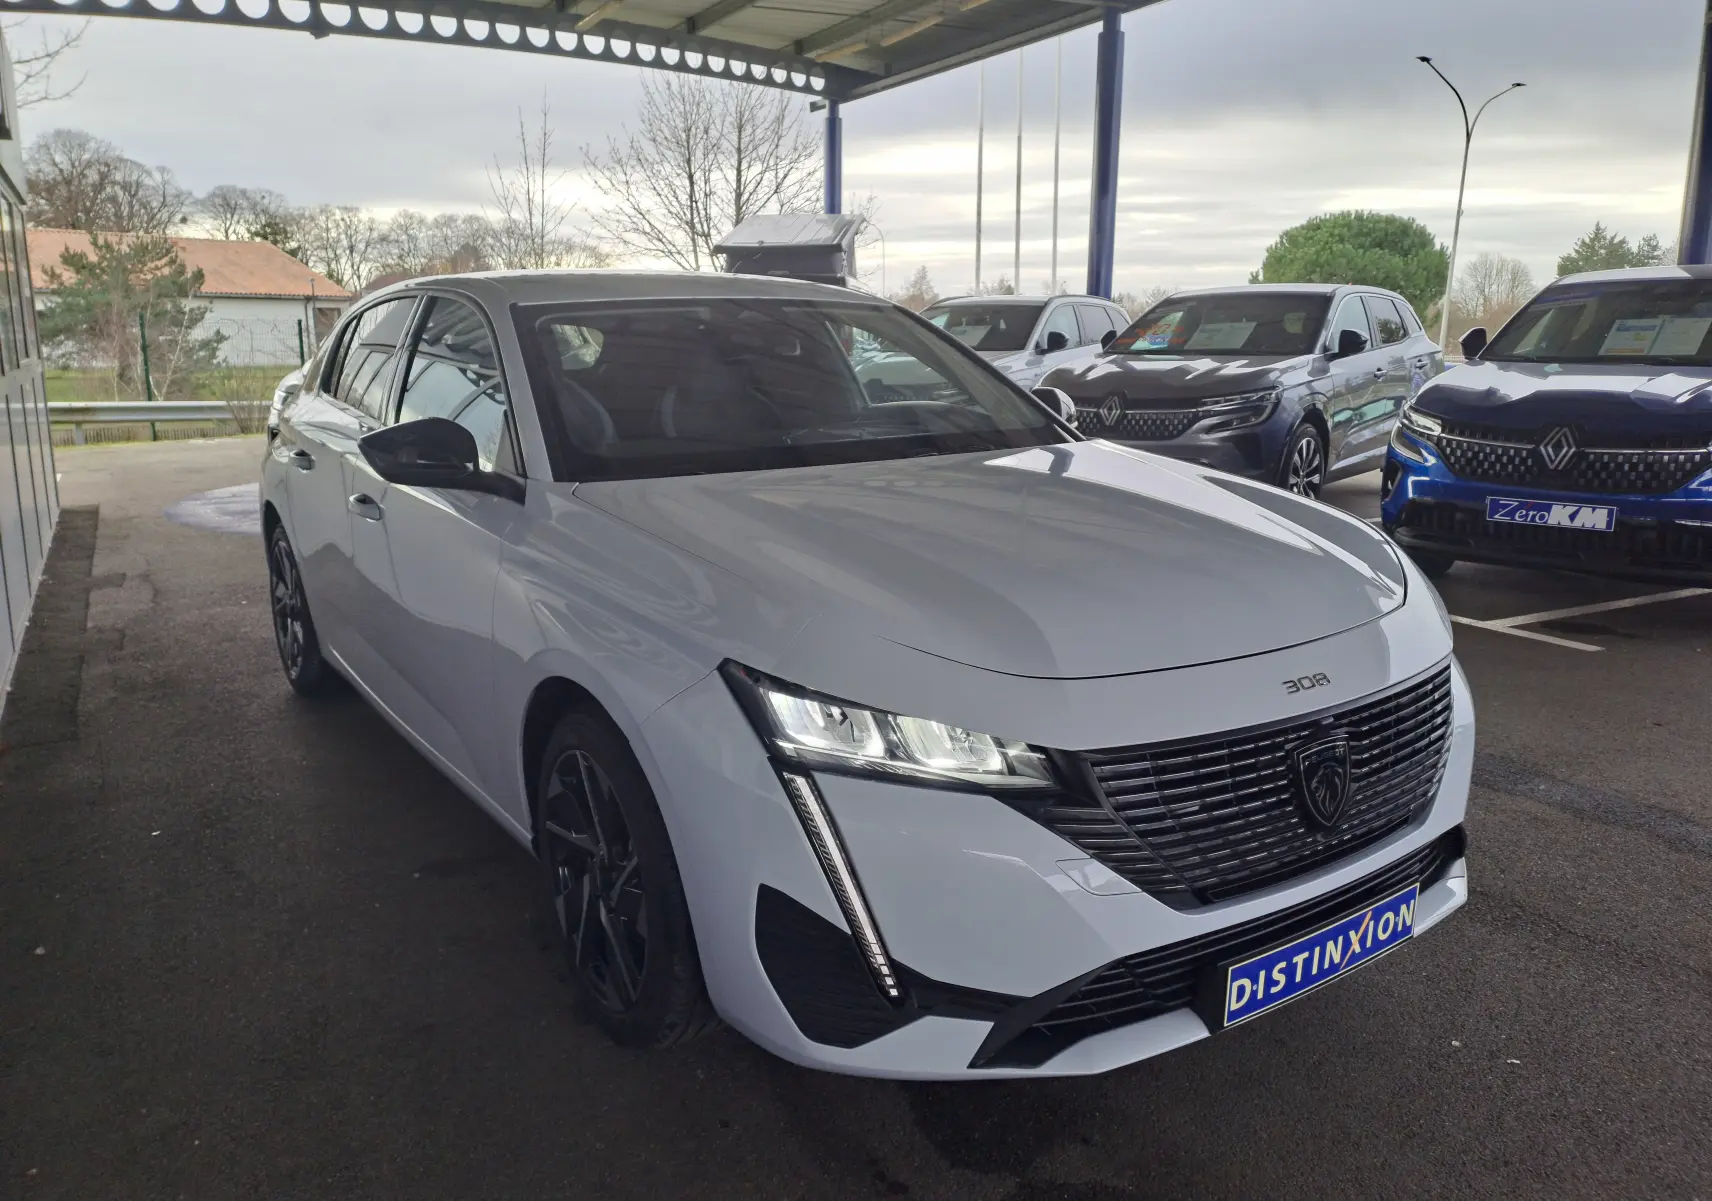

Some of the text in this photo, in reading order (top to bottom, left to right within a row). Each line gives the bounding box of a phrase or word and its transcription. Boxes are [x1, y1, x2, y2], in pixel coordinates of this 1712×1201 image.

[1281, 672, 1331, 695] 308
[1304, 747, 1345, 767] PEUGEOT
[1229, 899, 1415, 1012] DISTINXION
